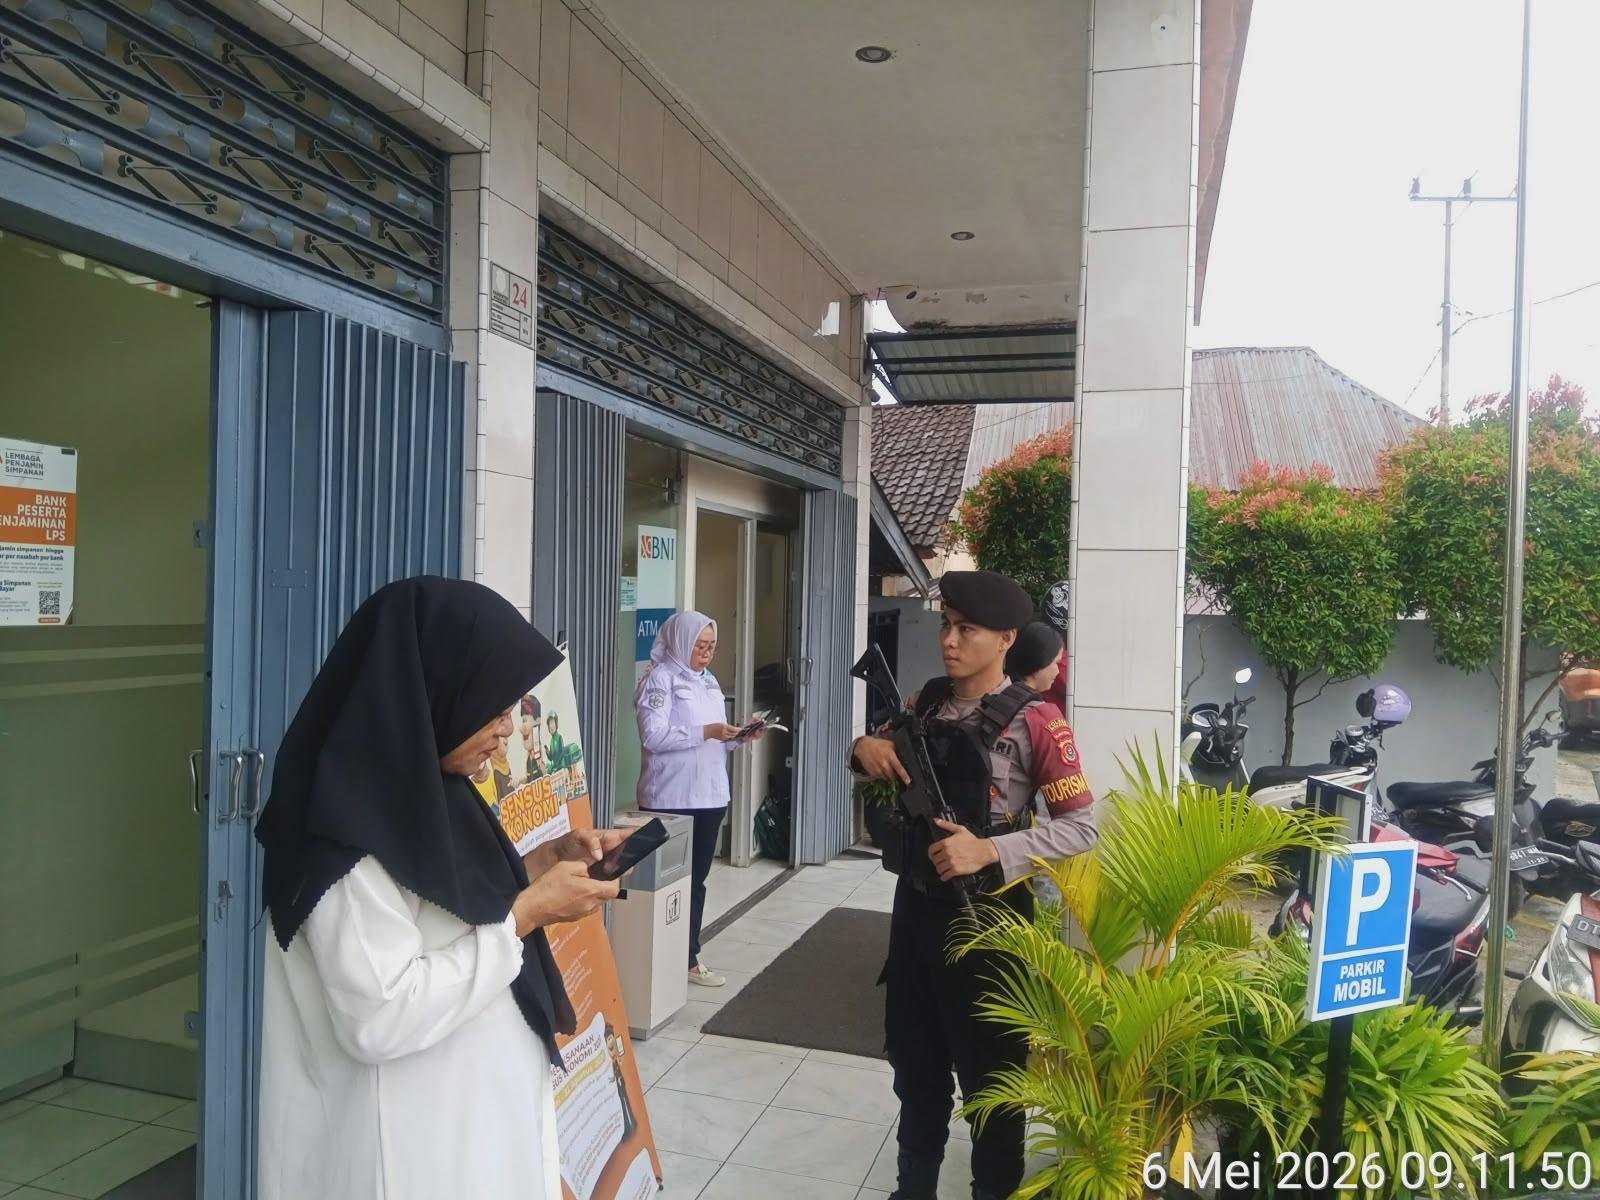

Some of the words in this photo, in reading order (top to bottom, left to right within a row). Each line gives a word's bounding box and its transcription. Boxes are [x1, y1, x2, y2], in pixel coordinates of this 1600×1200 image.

[512, 282, 528, 309] 24
[5, 452, 41, 462] LEMBAGA
[5, 459, 44, 470] PENJAMIN
[5, 466, 44, 476] SIMPANAN
[35, 494, 67, 507] BANK
[17, 504, 67, 518] PESERTA
[0, 514, 66, 530] ENJAMINAN
[46, 529, 66, 541] LPS
[652, 536, 675, 560] BNI
[637, 619, 658, 637] ATM
[501, 775, 553, 823] SENSUS
[504, 793, 559, 843] KONOMI
[1346, 857, 1392, 946] P
[1340, 958, 1385, 980] PARKIR
[1333, 976, 1386, 1003] MOBIL
